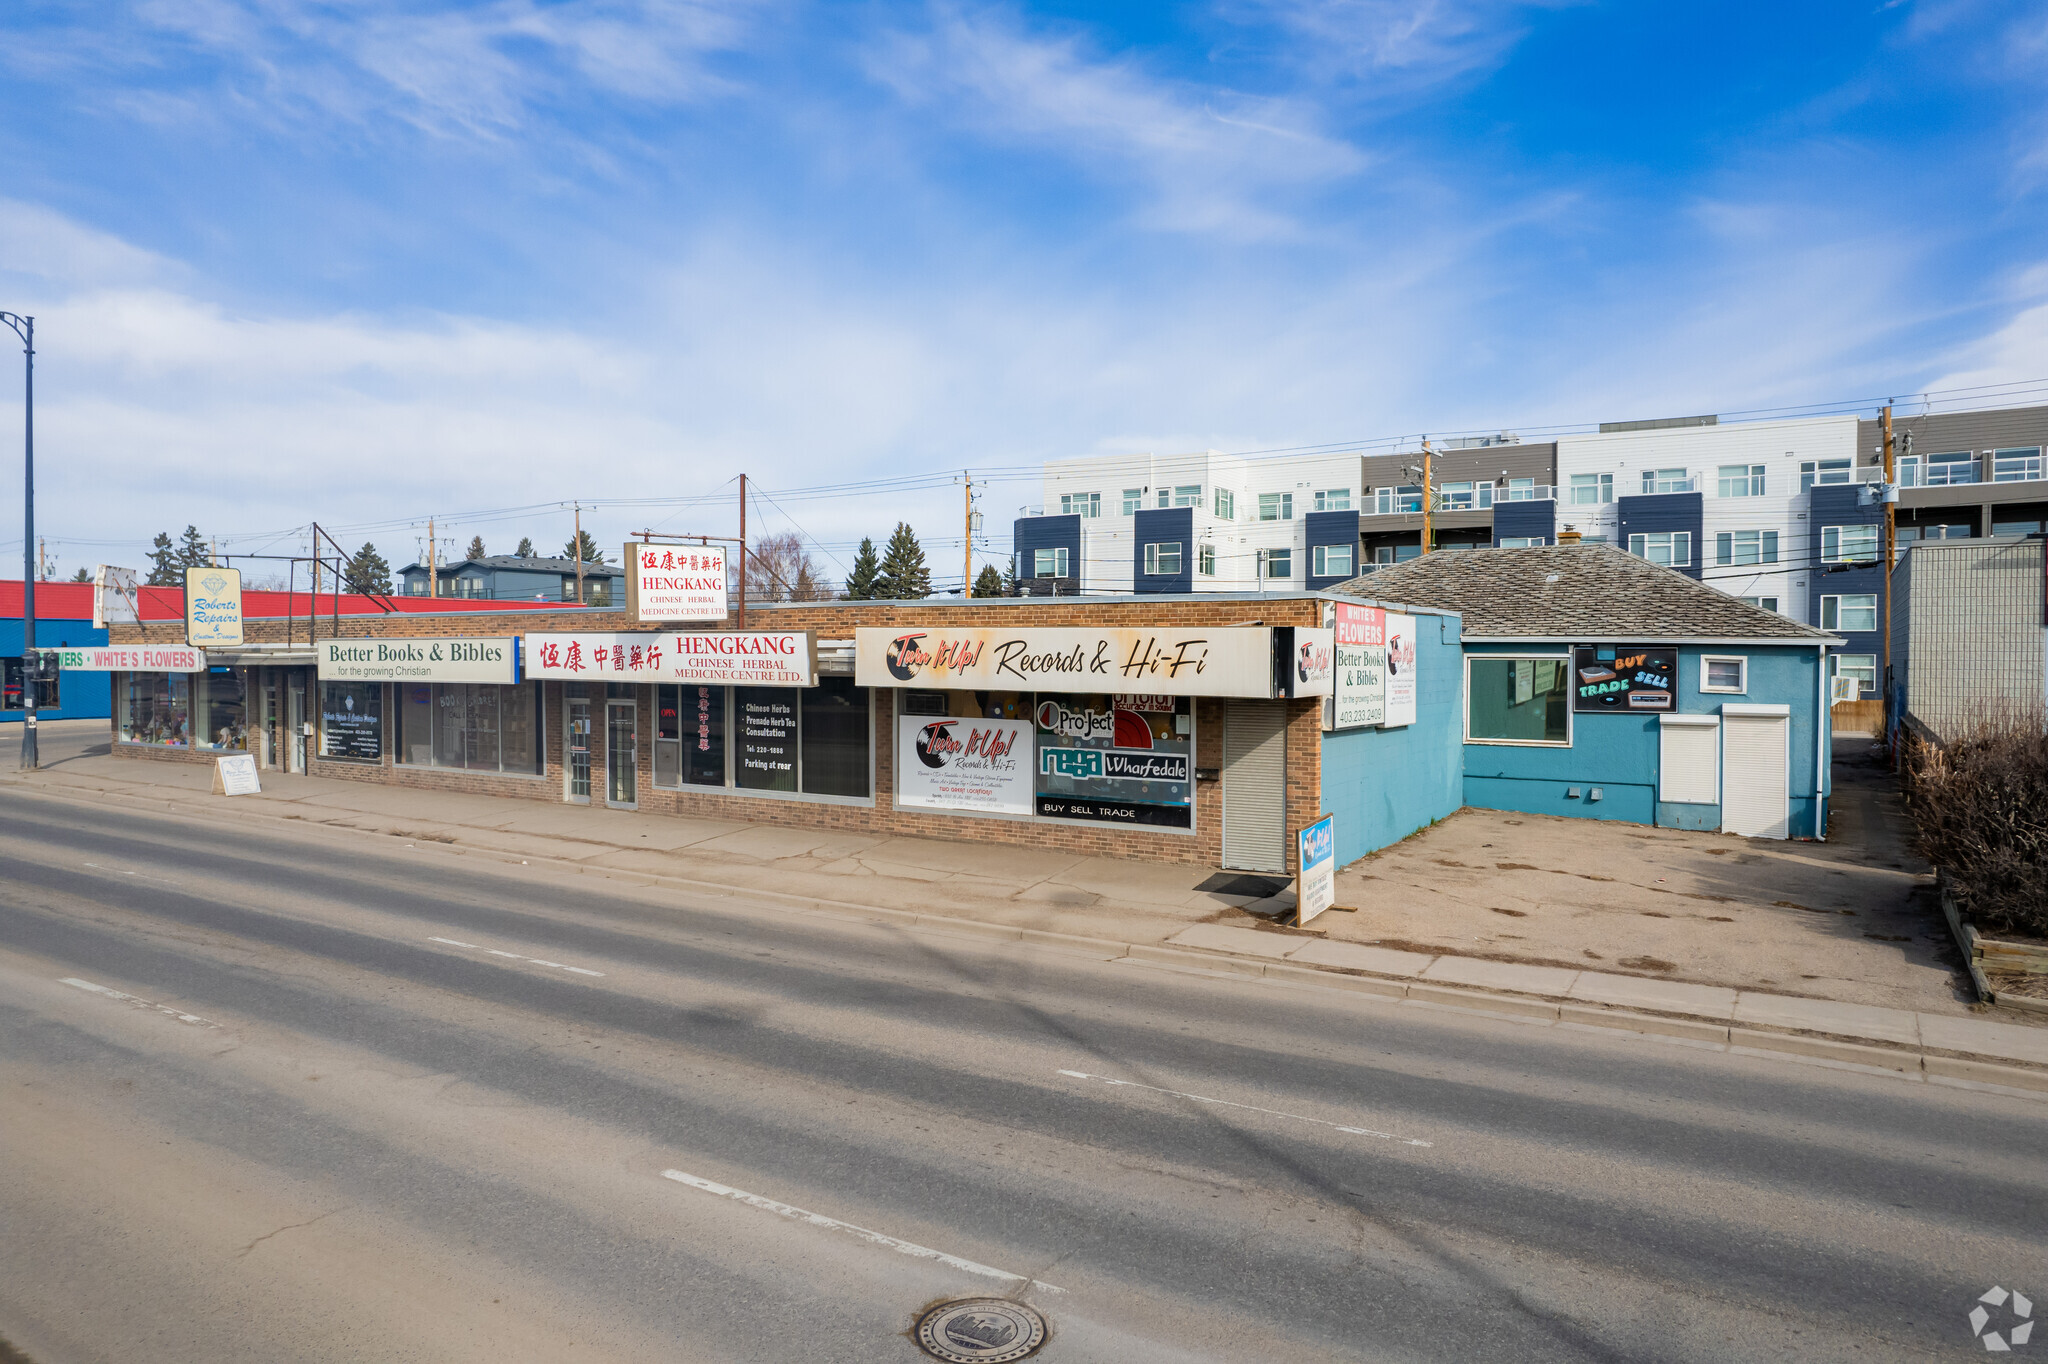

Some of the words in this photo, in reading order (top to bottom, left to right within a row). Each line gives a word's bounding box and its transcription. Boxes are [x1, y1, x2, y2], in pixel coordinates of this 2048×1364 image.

[643, 577, 722, 590] HENGKANG
[194, 598, 236, 610] Roberts
[650, 596, 682, 604] CHINESE
[193, 612, 238, 625] Repairs
[1347, 606, 1375, 622] WHITE'S
[213, 624, 219, 632] &
[1340, 622, 1382, 643] FLOWERS
[329, 645, 373, 662] Better
[377, 644, 424, 662] Books
[430, 643, 443, 661] &
[451, 643, 501, 662] Bibles
[676, 637, 795, 655] HENGKANG
[94, 652, 138, 667] WHITE'S
[144, 651, 194, 667] FLOWERS
[896, 633, 932, 667] Turn
[932, 639, 950, 669] It
[948, 639, 984, 676] Up!
[994, 640, 1084, 681] Records
[1090, 640, 1111, 674] &
[1120, 637, 1208, 678] Hi-Fi
[1338, 650, 1361, 666] Better
[1363, 651, 1384, 667] Books
[1615, 654, 1647, 670] BUY
[688, 658, 734, 669] CHINESE
[742, 660, 787, 670] HERBAL
[338, 666, 348, 675] for
[350, 666, 361, 676] the
[364, 666, 394, 678] growing
[395, 666, 431, 676] Christian
[675, 669, 730, 680] MEDICINE
[730, 670, 776, 681] CENTRE
[778, 671, 803, 682] LTD.
[1346, 671, 1353, 686] &
[1357, 670, 1378, 686] Bibles
[1634, 671, 1668, 688] SELL
[1579, 679, 1630, 697] TRADE
[661, 708, 676, 717] OPEN
[746, 704, 770, 713] Chinese
[772, 705, 790, 713] Herbs
[746, 715, 770, 725] Premade
[771, 717, 785, 727] Herb
[785, 718, 796, 727] Tea
[1060, 711, 1112, 737] Pro-Ject
[746, 727, 786, 737] Consultation
[926, 721, 963, 754] Turn
[964, 728, 982, 756] It
[980, 729, 1017, 763] Up!
[745, 759, 767, 770] Parking
[769, 761, 776, 769] at
[955, 757, 981, 770] Records
[983, 759, 988, 769] &
[992, 759, 1016, 771] Hi-Fi
[1106, 756, 1185, 778] Wharfedale
[1044, 804, 1065, 813] BUY
[1071, 806, 1093, 815] SELL
[1099, 808, 1135, 818] TRADE
